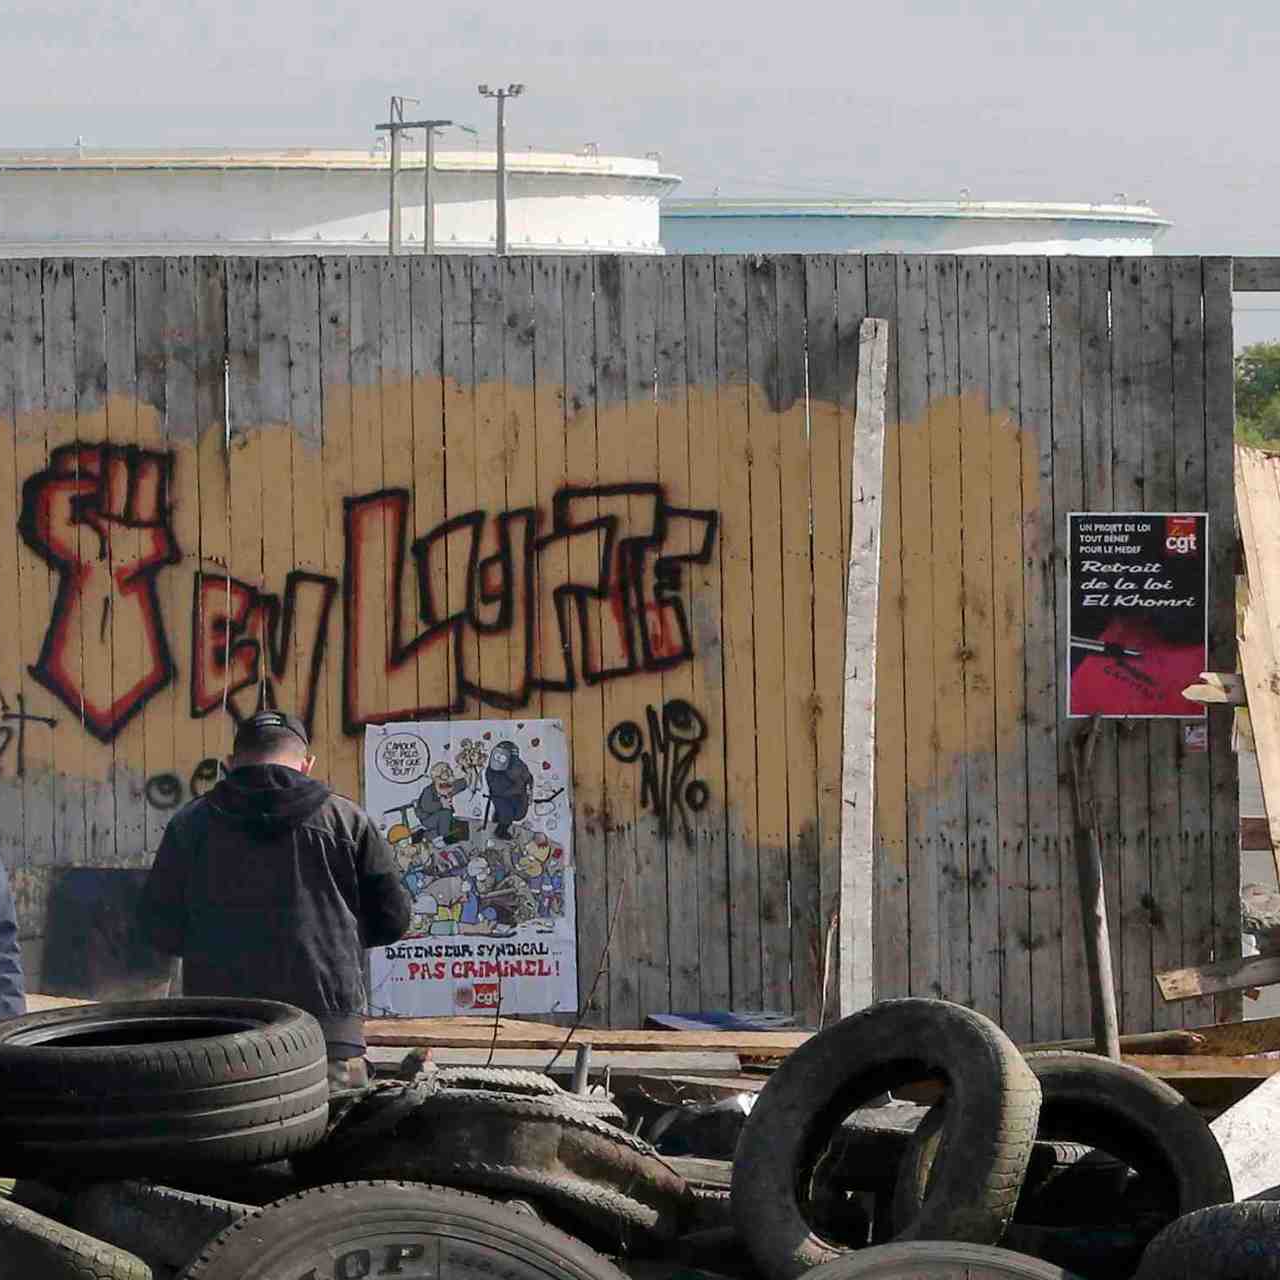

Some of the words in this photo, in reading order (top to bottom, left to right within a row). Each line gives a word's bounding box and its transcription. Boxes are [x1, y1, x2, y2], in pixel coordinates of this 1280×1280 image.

[1079, 524, 1093, 532] UN
[1094, 524, 1122, 533] PROJET
[1124, 524, 1135, 532] DE
[1137, 523, 1151, 532] LOI
[1166, 533, 1197, 553] cgt
[1081, 561, 1162, 573] Retrait
[1081, 578, 1109, 589] de
[1114, 578, 1138, 590] la
[1144, 578, 1173, 590] loi
[1082, 595, 1109, 607] El
[1114, 594, 1197, 607] Khomri
[476, 992, 500, 1007] cgt
